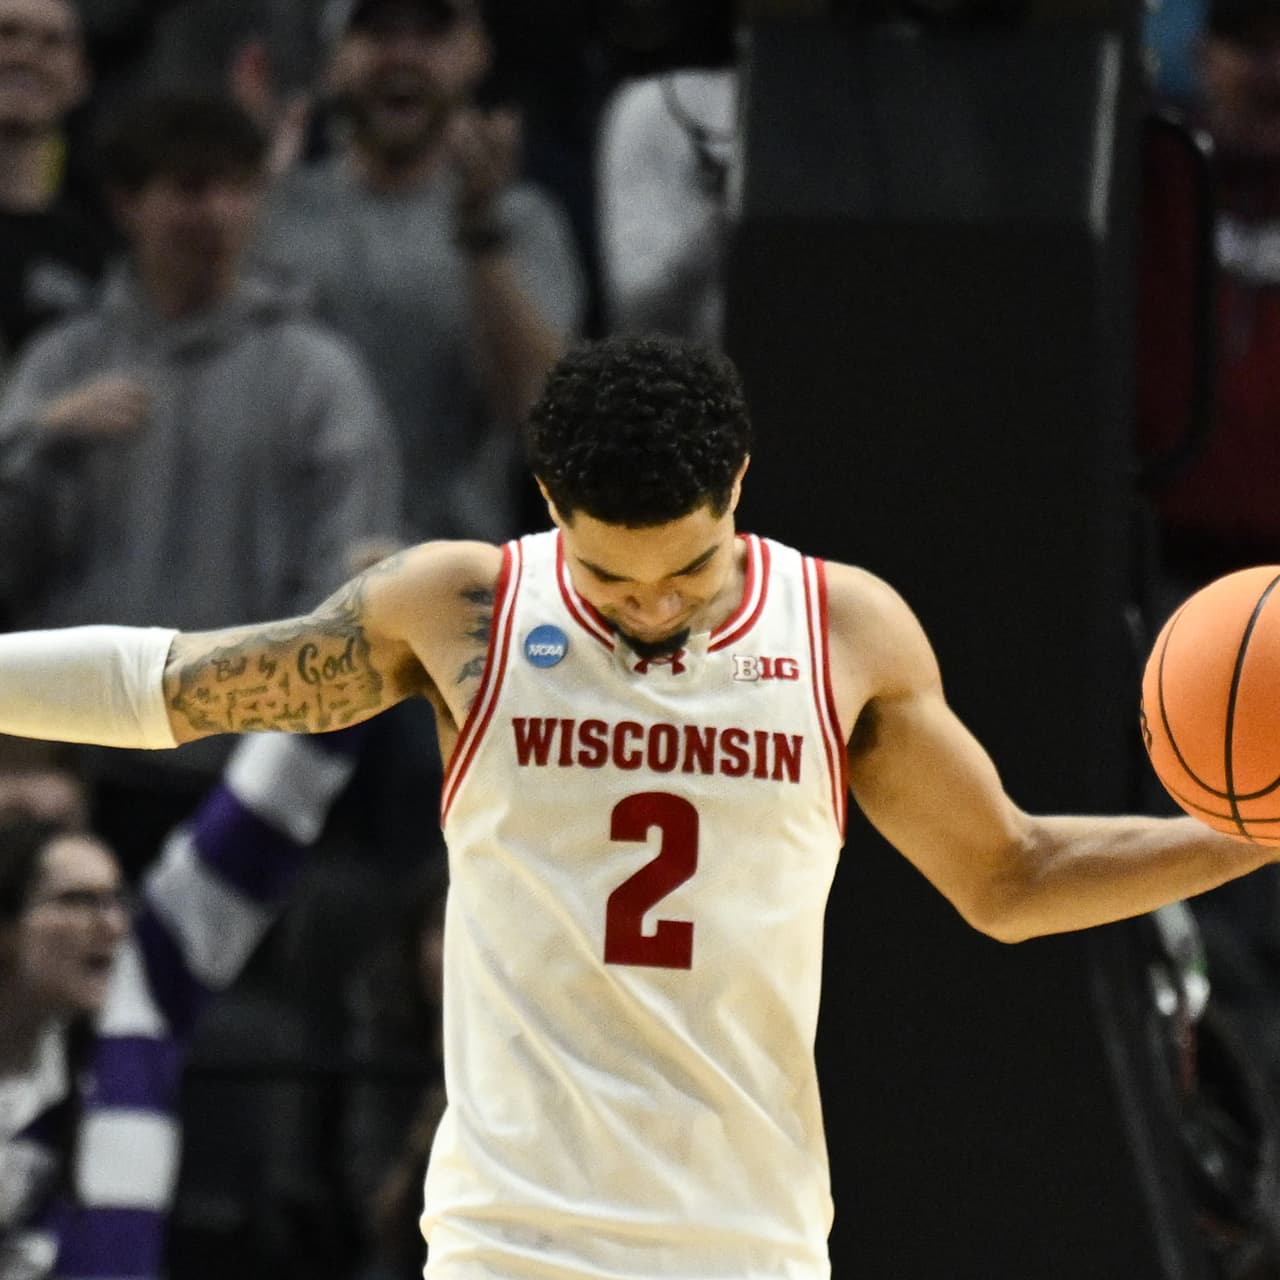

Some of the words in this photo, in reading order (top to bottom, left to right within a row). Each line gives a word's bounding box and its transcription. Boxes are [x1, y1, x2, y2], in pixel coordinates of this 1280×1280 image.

[296, 635, 355, 685] God
[528, 643, 564, 656] NCAA
[513, 717, 803, 782] WISCONSIN
[605, 791, 698, 969] 2
